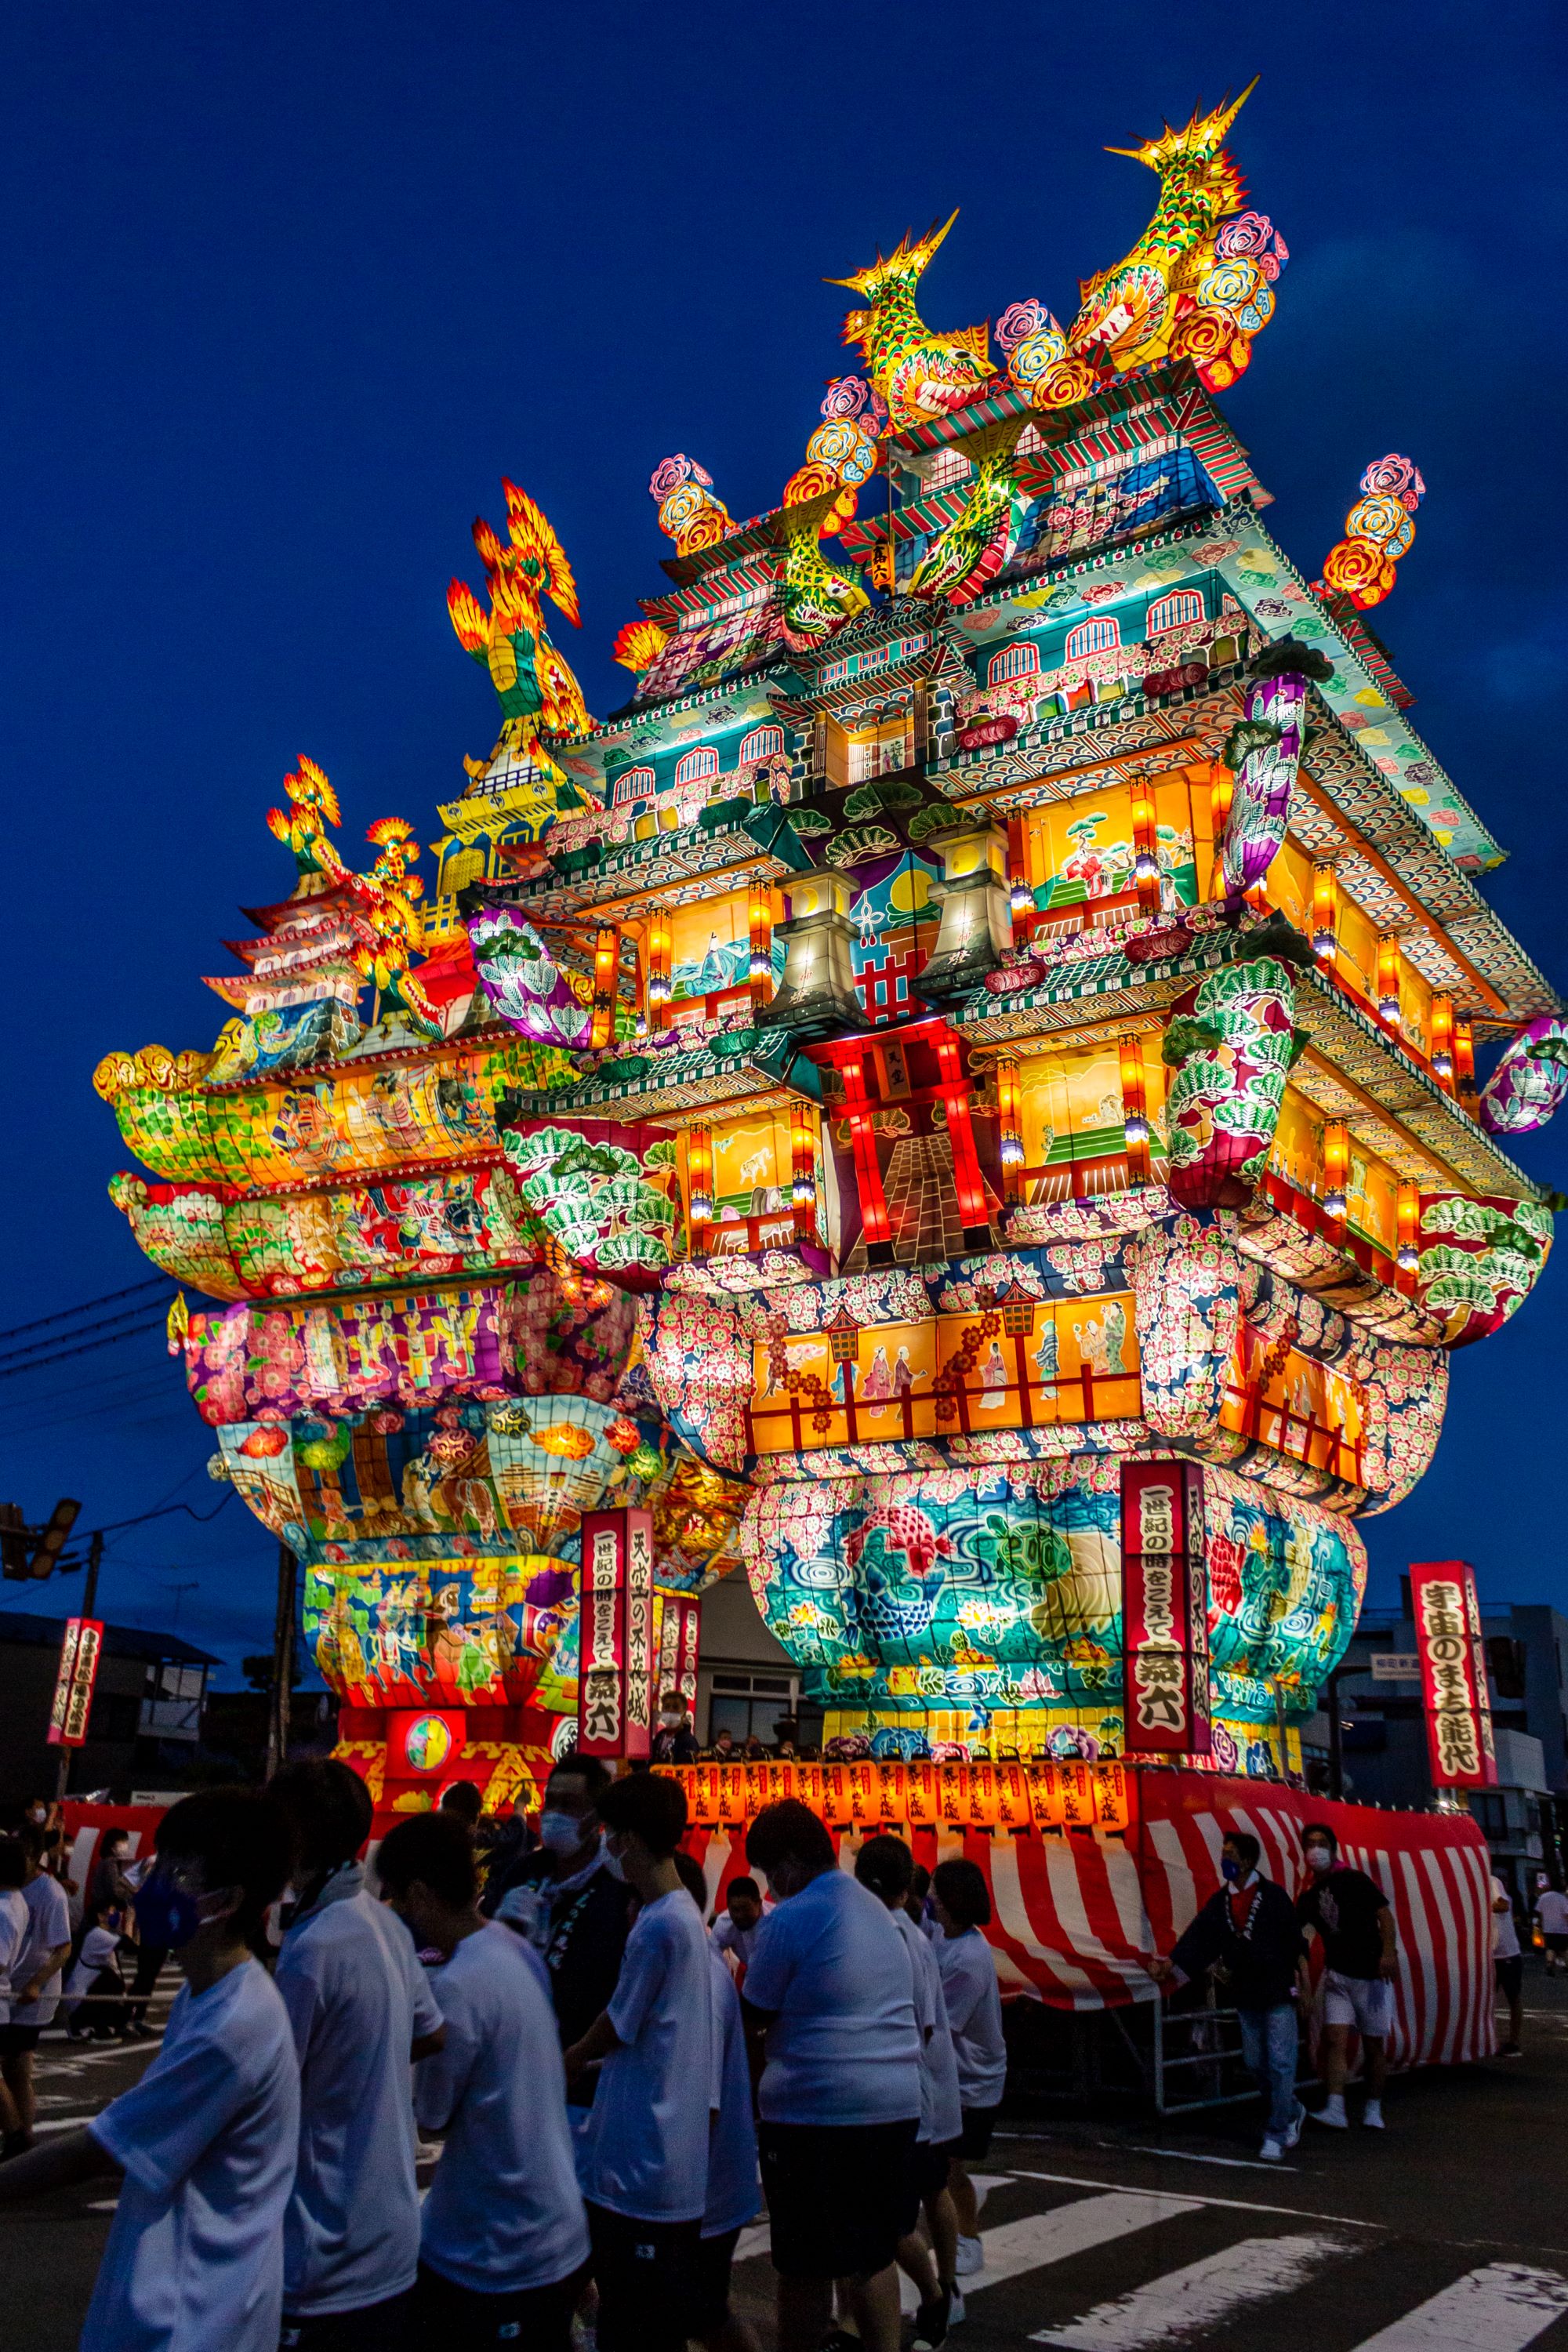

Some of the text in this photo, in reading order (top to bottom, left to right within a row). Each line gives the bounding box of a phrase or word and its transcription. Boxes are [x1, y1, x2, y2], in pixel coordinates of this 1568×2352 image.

[888, 1051, 904, 1085] 天空
[627, 1531, 650, 1726] 天空の不夜城
[1425, 1584, 1476, 1771] 宇宙のまち能代
